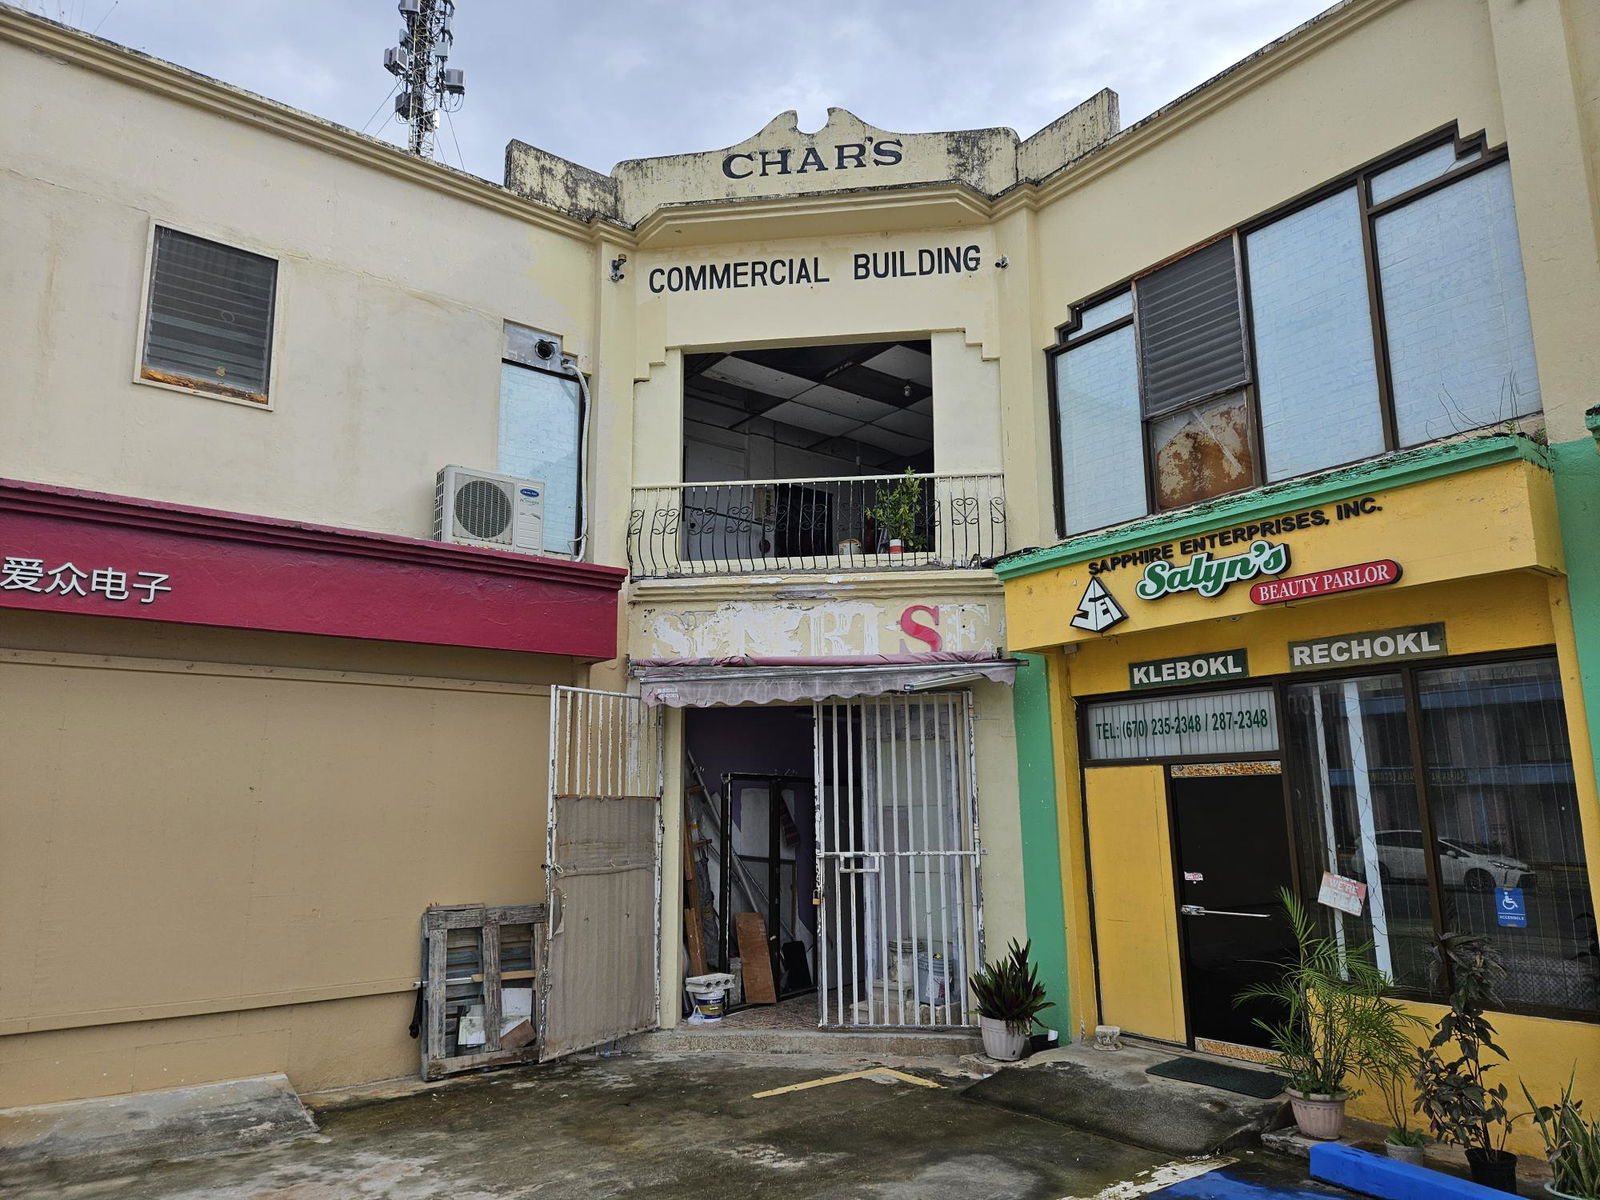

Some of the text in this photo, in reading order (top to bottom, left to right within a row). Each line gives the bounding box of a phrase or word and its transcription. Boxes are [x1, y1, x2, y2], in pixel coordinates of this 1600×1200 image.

[722, 137, 903, 179] CHAR'S
[649, 245, 981, 294] COMMERCIAL BUILDING
[1088, 496, 1383, 576] SAPPHIRE ENTERPRISES, INC.
[0, 556, 172, 604] 爱众电子
[1136, 540, 1290, 600] Salyn's
[1259, 564, 1391, 602] BEAUTY PARLOR
[1293, 631, 1440, 666] RECHOKL
[1133, 655, 1242, 685] KLEBOKL
[1095, 723, 1120, 740] TEL:
[1122, 719, 1149, 739] (670)
[1151, 714, 1201, 736] 235-2348
[1211, 708, 1268, 732] 287-2348
